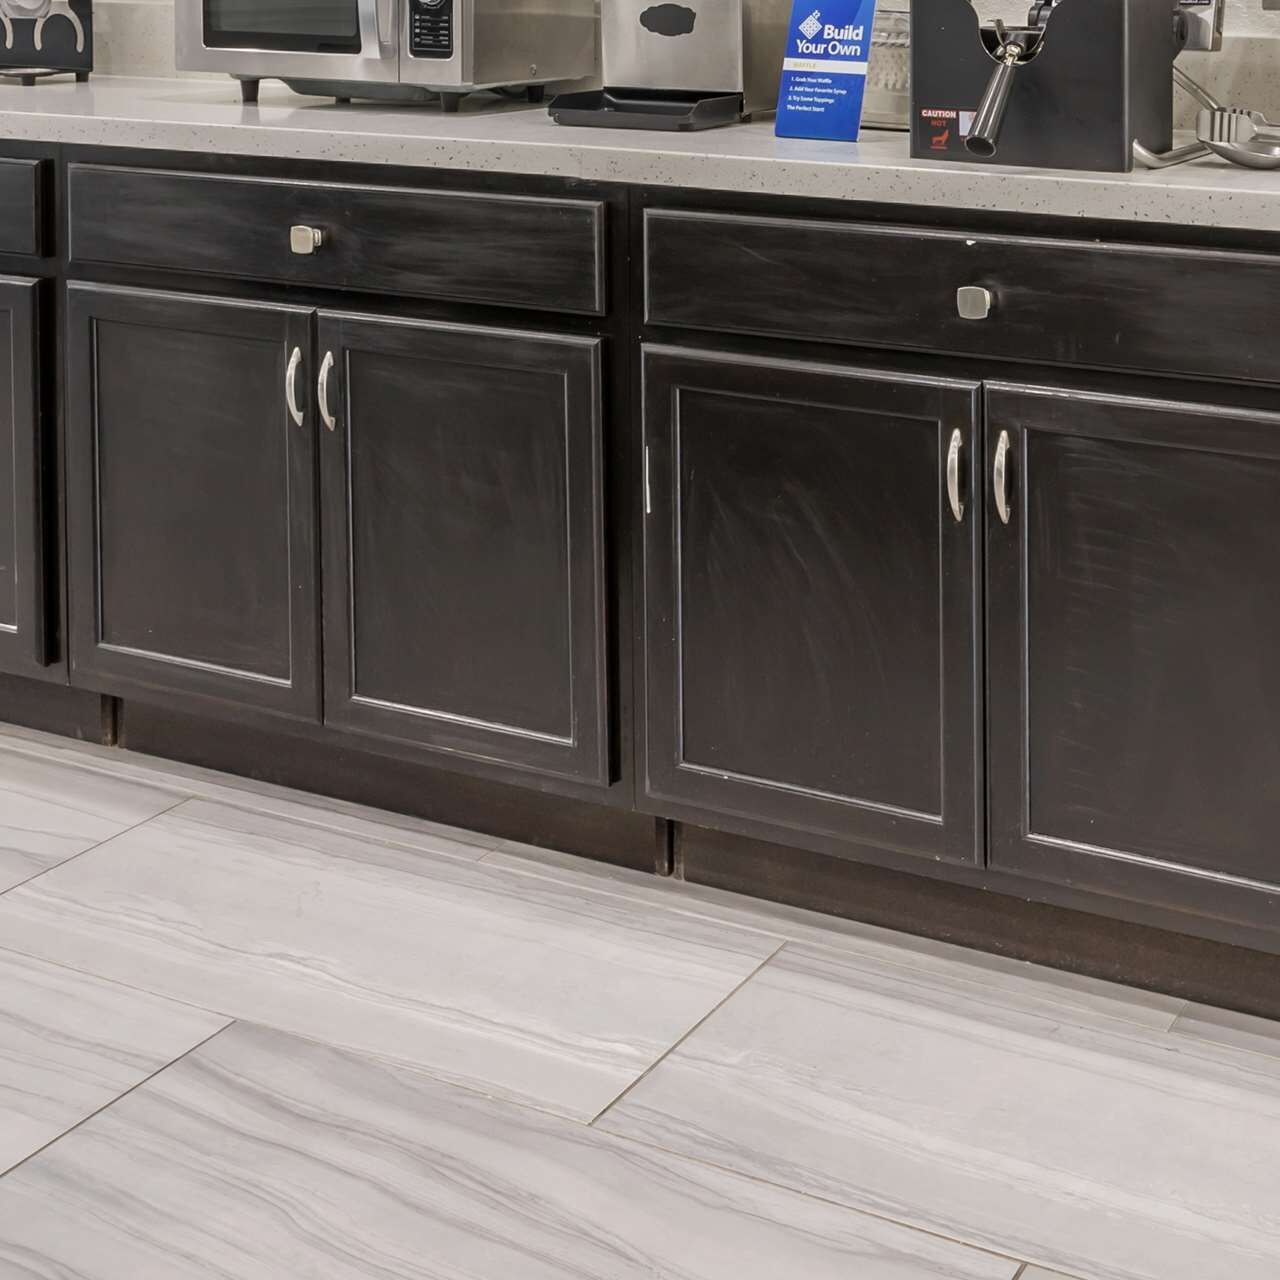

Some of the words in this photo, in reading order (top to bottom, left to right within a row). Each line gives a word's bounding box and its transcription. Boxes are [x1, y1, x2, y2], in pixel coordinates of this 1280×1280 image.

[823, 24, 864, 40] Build
[796, 39, 827, 54] Your
[828, 40, 861, 56] Own
[922, 110, 957, 118] CAUTION
